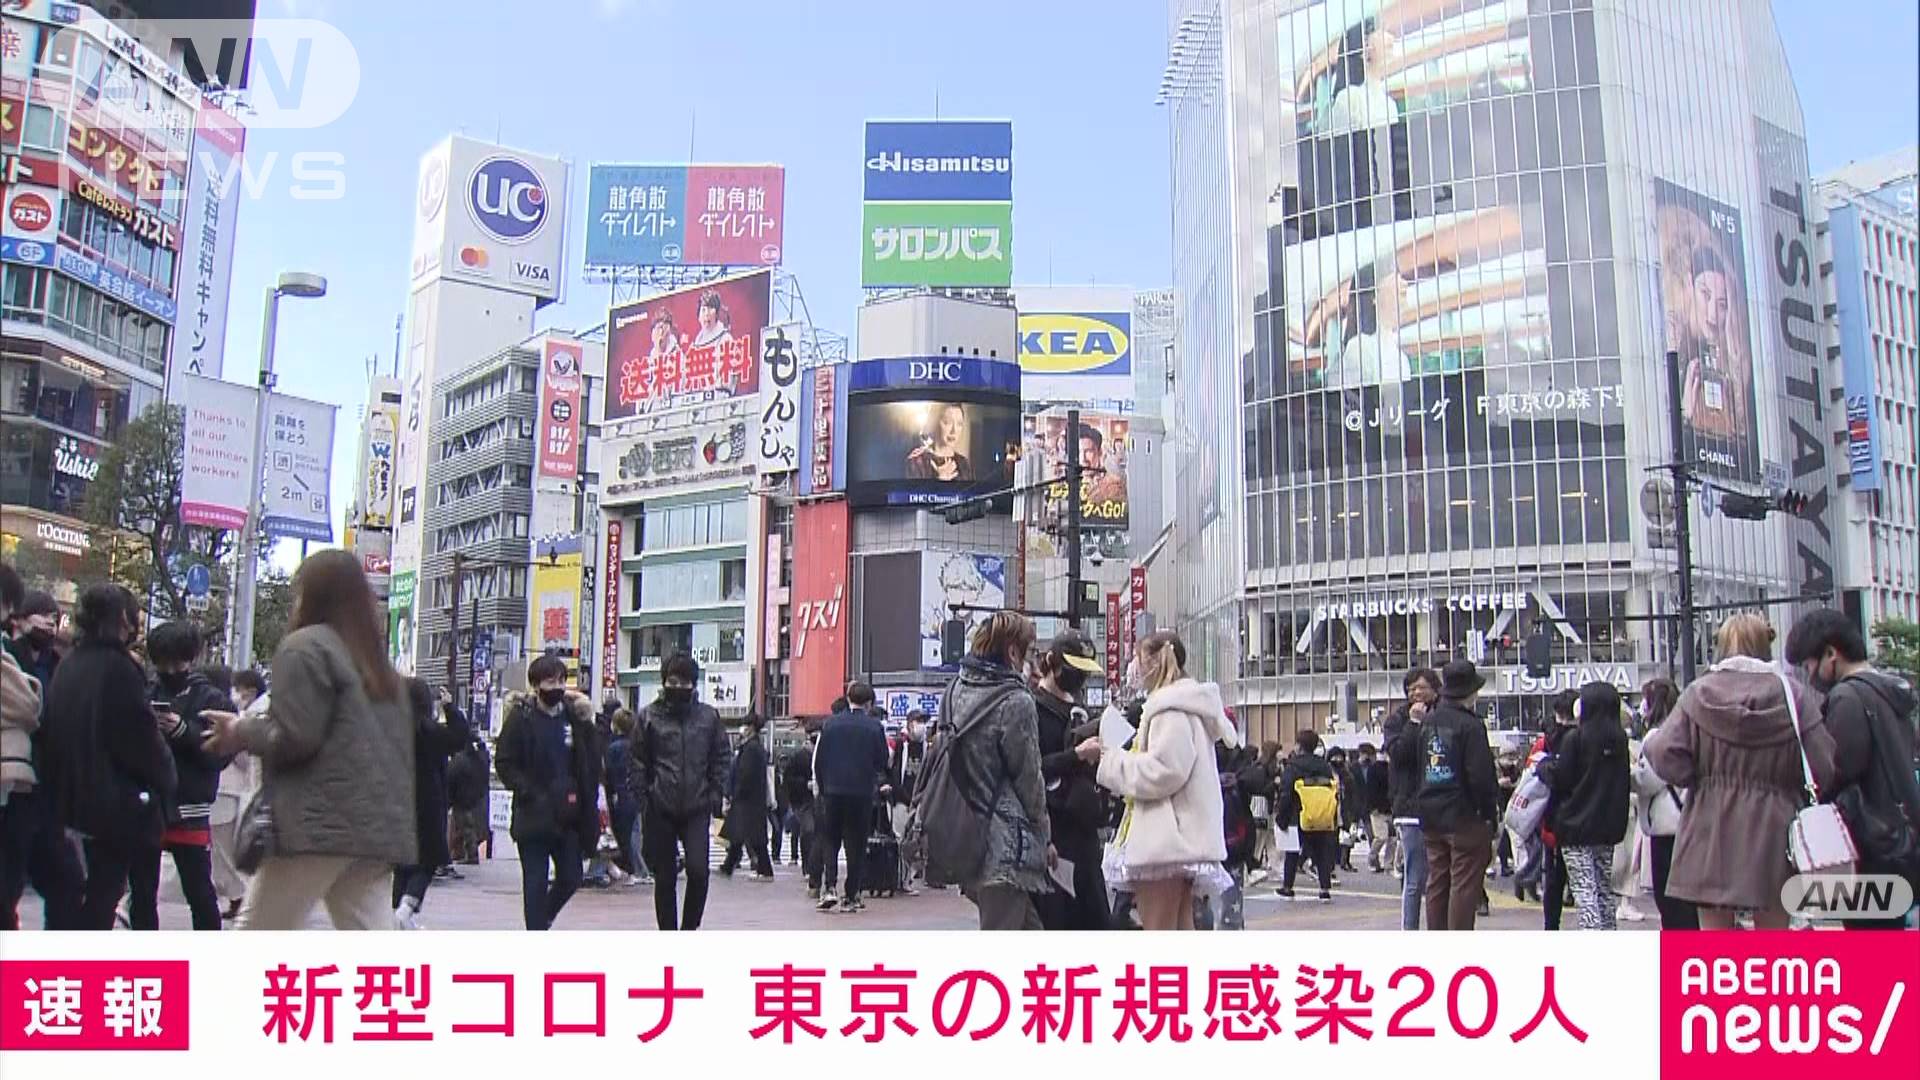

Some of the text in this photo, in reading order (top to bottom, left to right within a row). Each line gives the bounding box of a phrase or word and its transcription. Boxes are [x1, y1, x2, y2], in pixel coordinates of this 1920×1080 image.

[69, 120, 159, 192] コンタクト
[867, 152, 1010, 172] Hisamitsu
[609, 185, 667, 211] 龍角散
[707, 186, 766, 212] 龍角散
[13, 208, 48, 223] ガスト
[133, 209, 174, 247] ガスト
[872, 226, 1002, 261] サロンパス
[517, 262, 550, 281] VISA
[1019, 332, 1116, 355] KEA
[620, 334, 752, 407] 送料無料
[909, 361, 961, 381] DHC
[760, 327, 798, 467] もんじゃ
[1770, 181, 1835, 594] TSUTAYA
[193, 410, 246, 429] Thanks to
[192, 429, 227, 442] all our
[1848, 394, 1873, 475] SEIBU
[191, 444, 248, 464] healthcare
[1699, 448, 1736, 468] CHANEL
[909, 494, 928, 503] DHC
[1317, 592, 1527, 622] STARBUCKS COFFEE
[794, 583, 844, 658] クスリ
[1503, 668, 1634, 692] TSUTAYA
